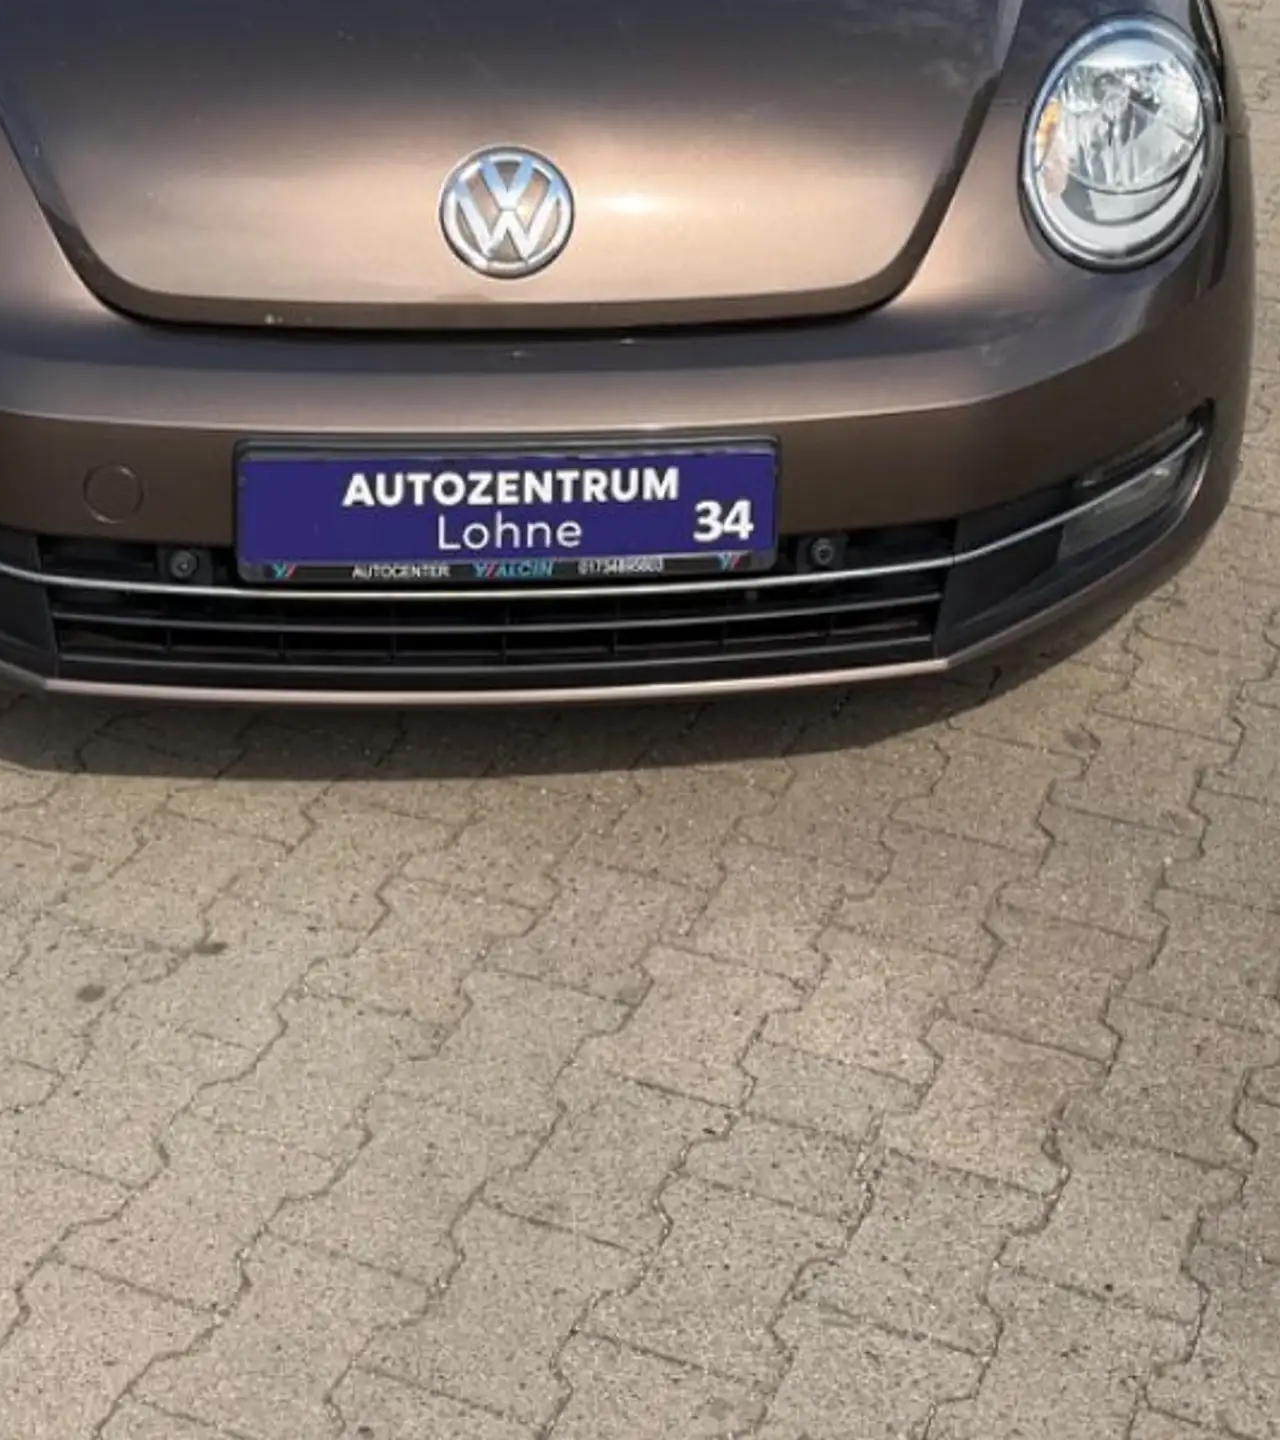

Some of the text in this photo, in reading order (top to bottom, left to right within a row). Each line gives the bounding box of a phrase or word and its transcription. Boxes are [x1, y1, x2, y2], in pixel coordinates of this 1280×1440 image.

[342, 466, 681, 508] AUTOZENTRUM
[437, 511, 584, 550] Lohne
[692, 499, 755, 542] 34
[352, 563, 452, 579] AUTOCENTER
